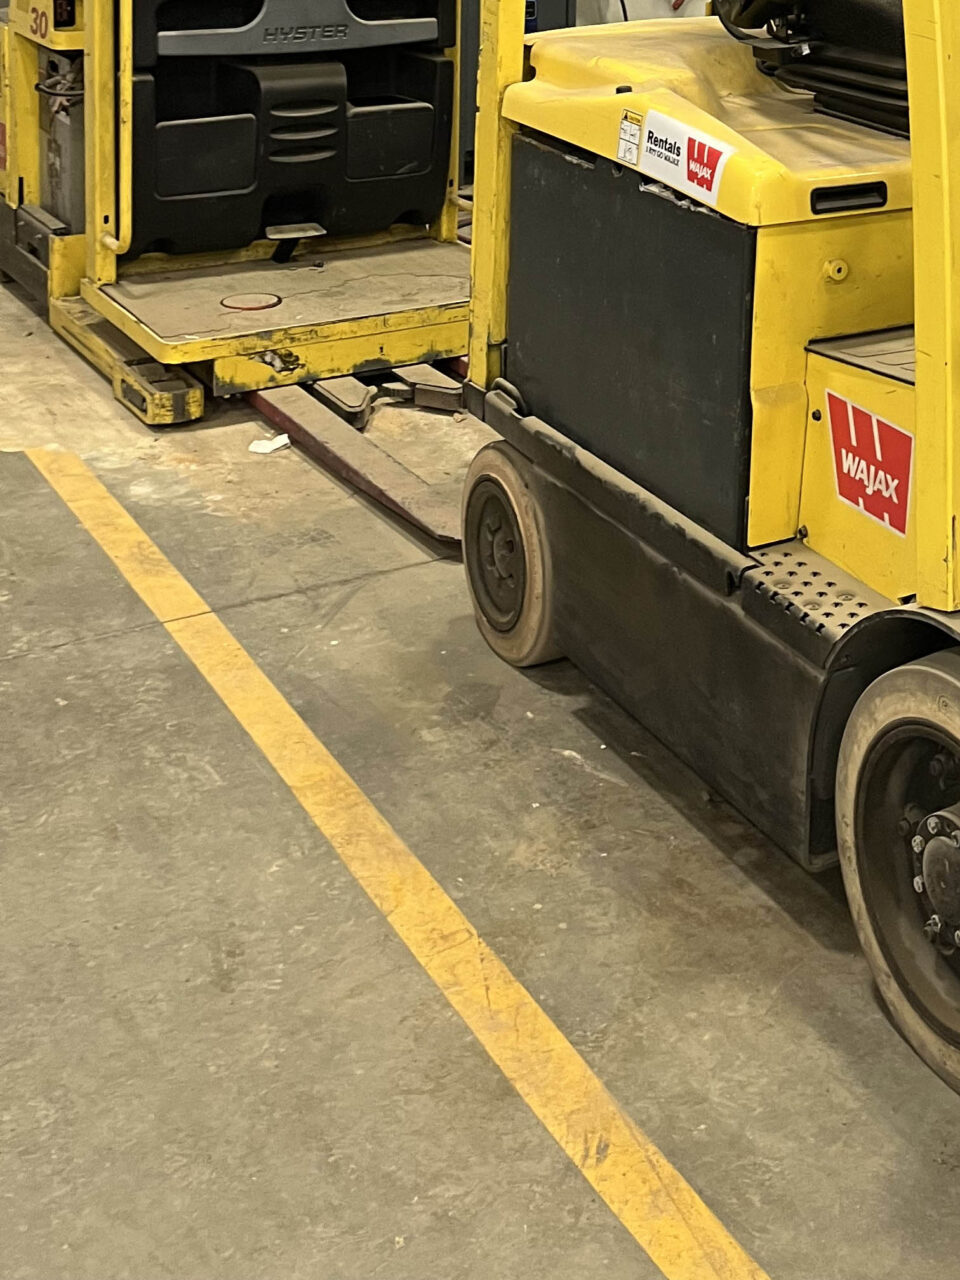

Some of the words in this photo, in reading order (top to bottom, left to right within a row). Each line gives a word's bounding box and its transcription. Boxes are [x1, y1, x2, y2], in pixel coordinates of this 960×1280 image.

[30, 7, 48, 39] 30
[263, 24, 349, 43] HYSTER
[647, 129, 681, 157] Rentals
[689, 159, 712, 180] WAJAX
[841, 447, 899, 504] WAJAX
